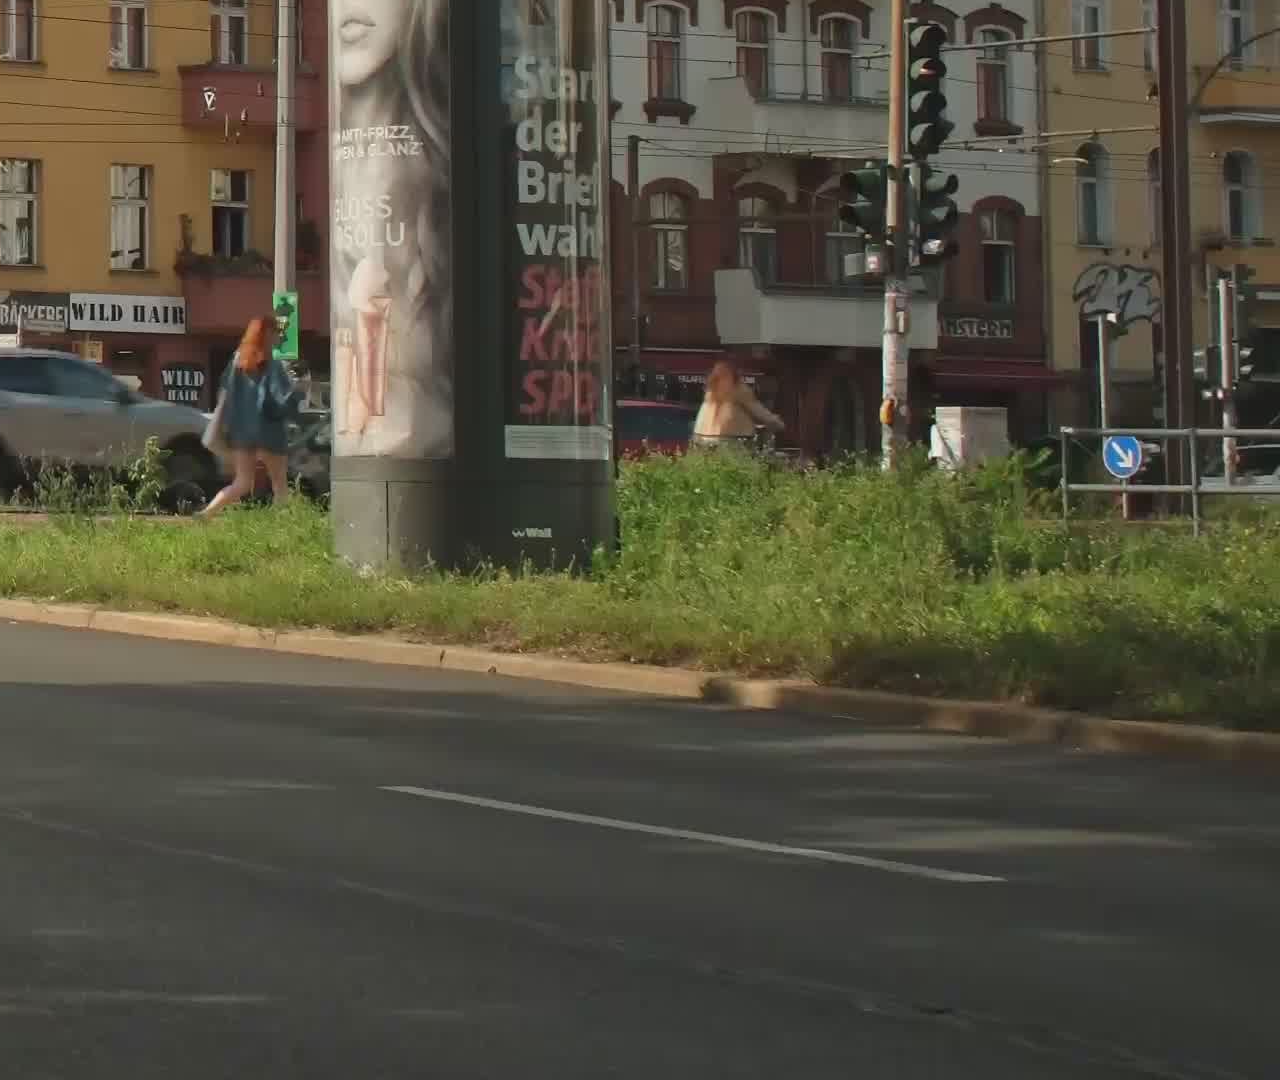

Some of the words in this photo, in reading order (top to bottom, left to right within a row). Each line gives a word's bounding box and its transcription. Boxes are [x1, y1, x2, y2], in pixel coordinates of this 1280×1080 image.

[515, 104, 584, 152] der
[516, 210, 600, 259] wah
[71, 301, 124, 325] WILD
[132, 304, 185, 327] HAIR
[161, 370, 206, 388] WILD
[519, 368, 598, 416] SPD
